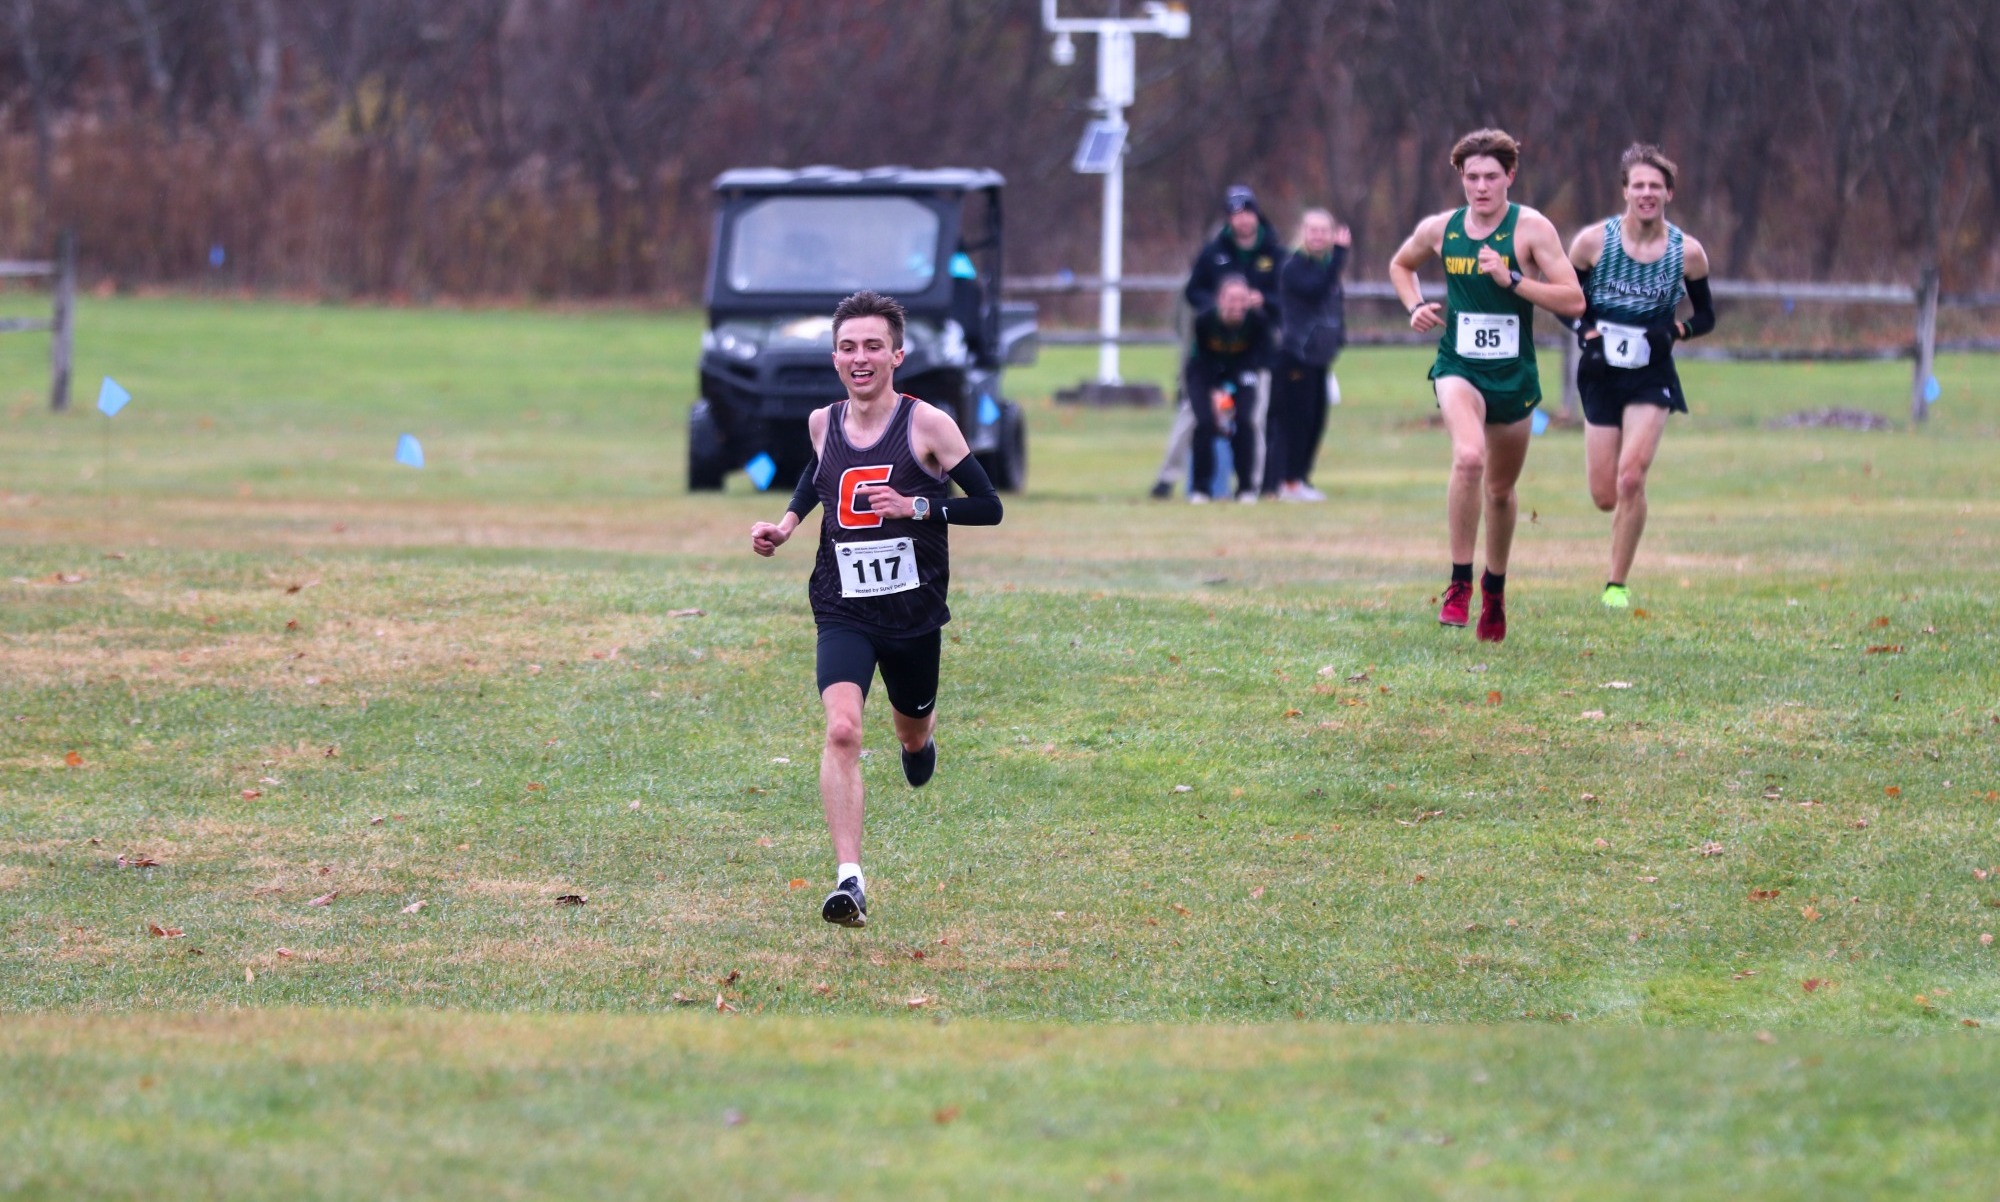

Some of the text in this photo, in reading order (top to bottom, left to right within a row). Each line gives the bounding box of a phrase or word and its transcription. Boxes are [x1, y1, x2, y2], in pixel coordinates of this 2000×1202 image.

[1445, 256, 1476, 275] SUNY
[1608, 280, 1669, 300] HUSSON
[1475, 329, 1501, 348] 85
[1616, 339, 1629, 357] 4
[837, 464, 894, 530] C
[852, 556, 902, 584] 117
